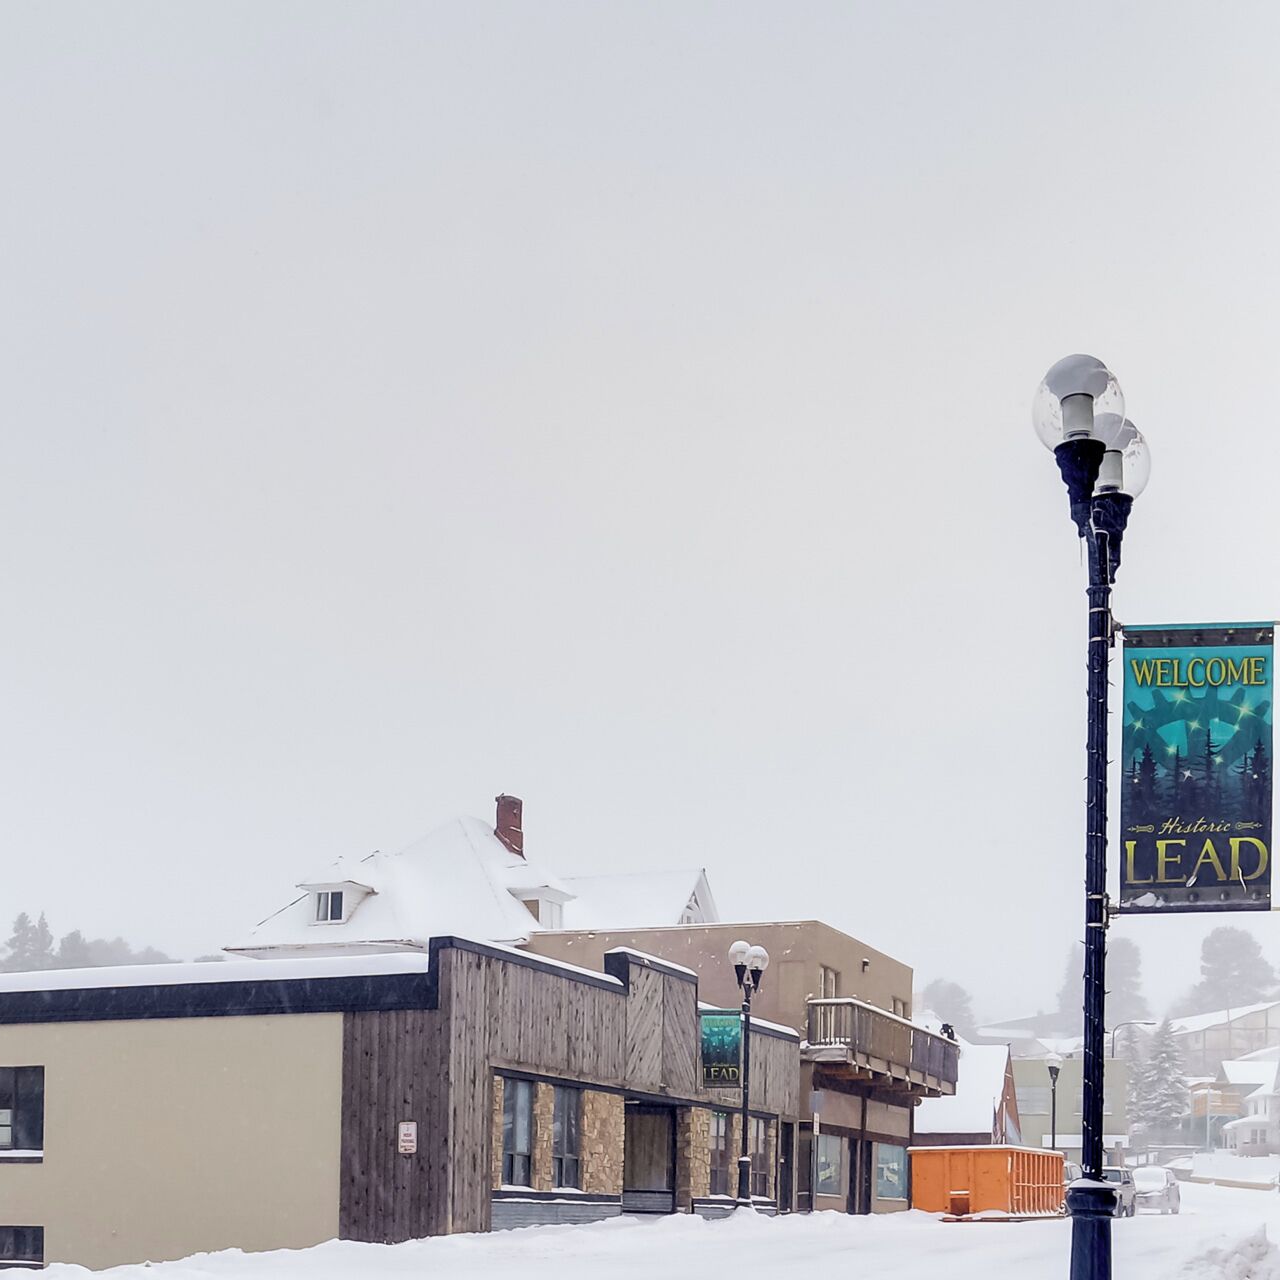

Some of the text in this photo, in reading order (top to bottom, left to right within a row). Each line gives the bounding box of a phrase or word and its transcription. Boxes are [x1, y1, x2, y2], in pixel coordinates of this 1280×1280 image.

[1131, 657, 1266, 688] WELCOME
[1158, 816, 1231, 835] Historic
[1124, 837, 1269, 886] LEAD
[703, 1067, 739, 1080] LEAD
